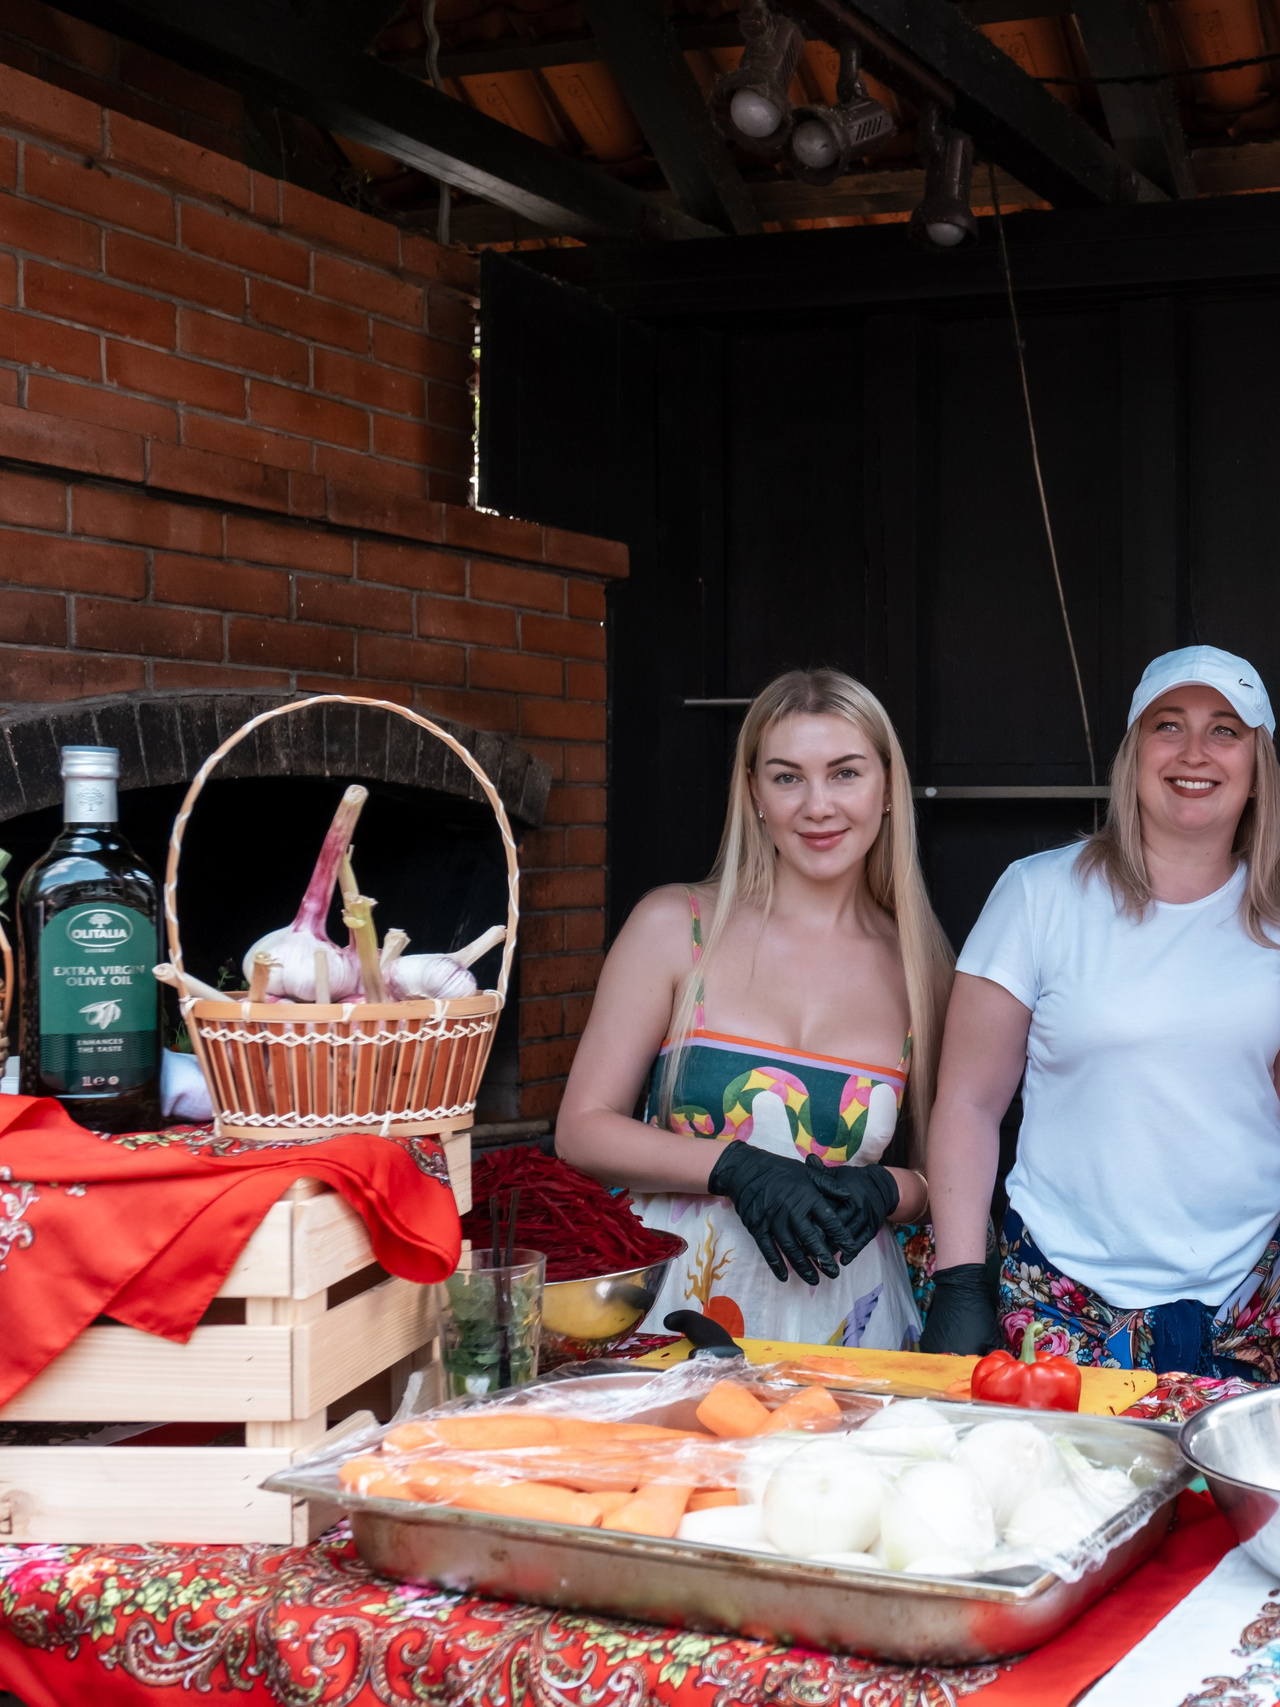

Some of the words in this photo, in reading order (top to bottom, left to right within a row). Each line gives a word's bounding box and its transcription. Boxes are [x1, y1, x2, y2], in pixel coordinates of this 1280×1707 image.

[72, 929, 127, 939] OLITALIA
[53, 966, 96, 976] EXTRA
[100, 965, 145, 975] VIRGIN
[66, 977, 106, 986] OLIVE
[110, 976, 133, 985] OIL
